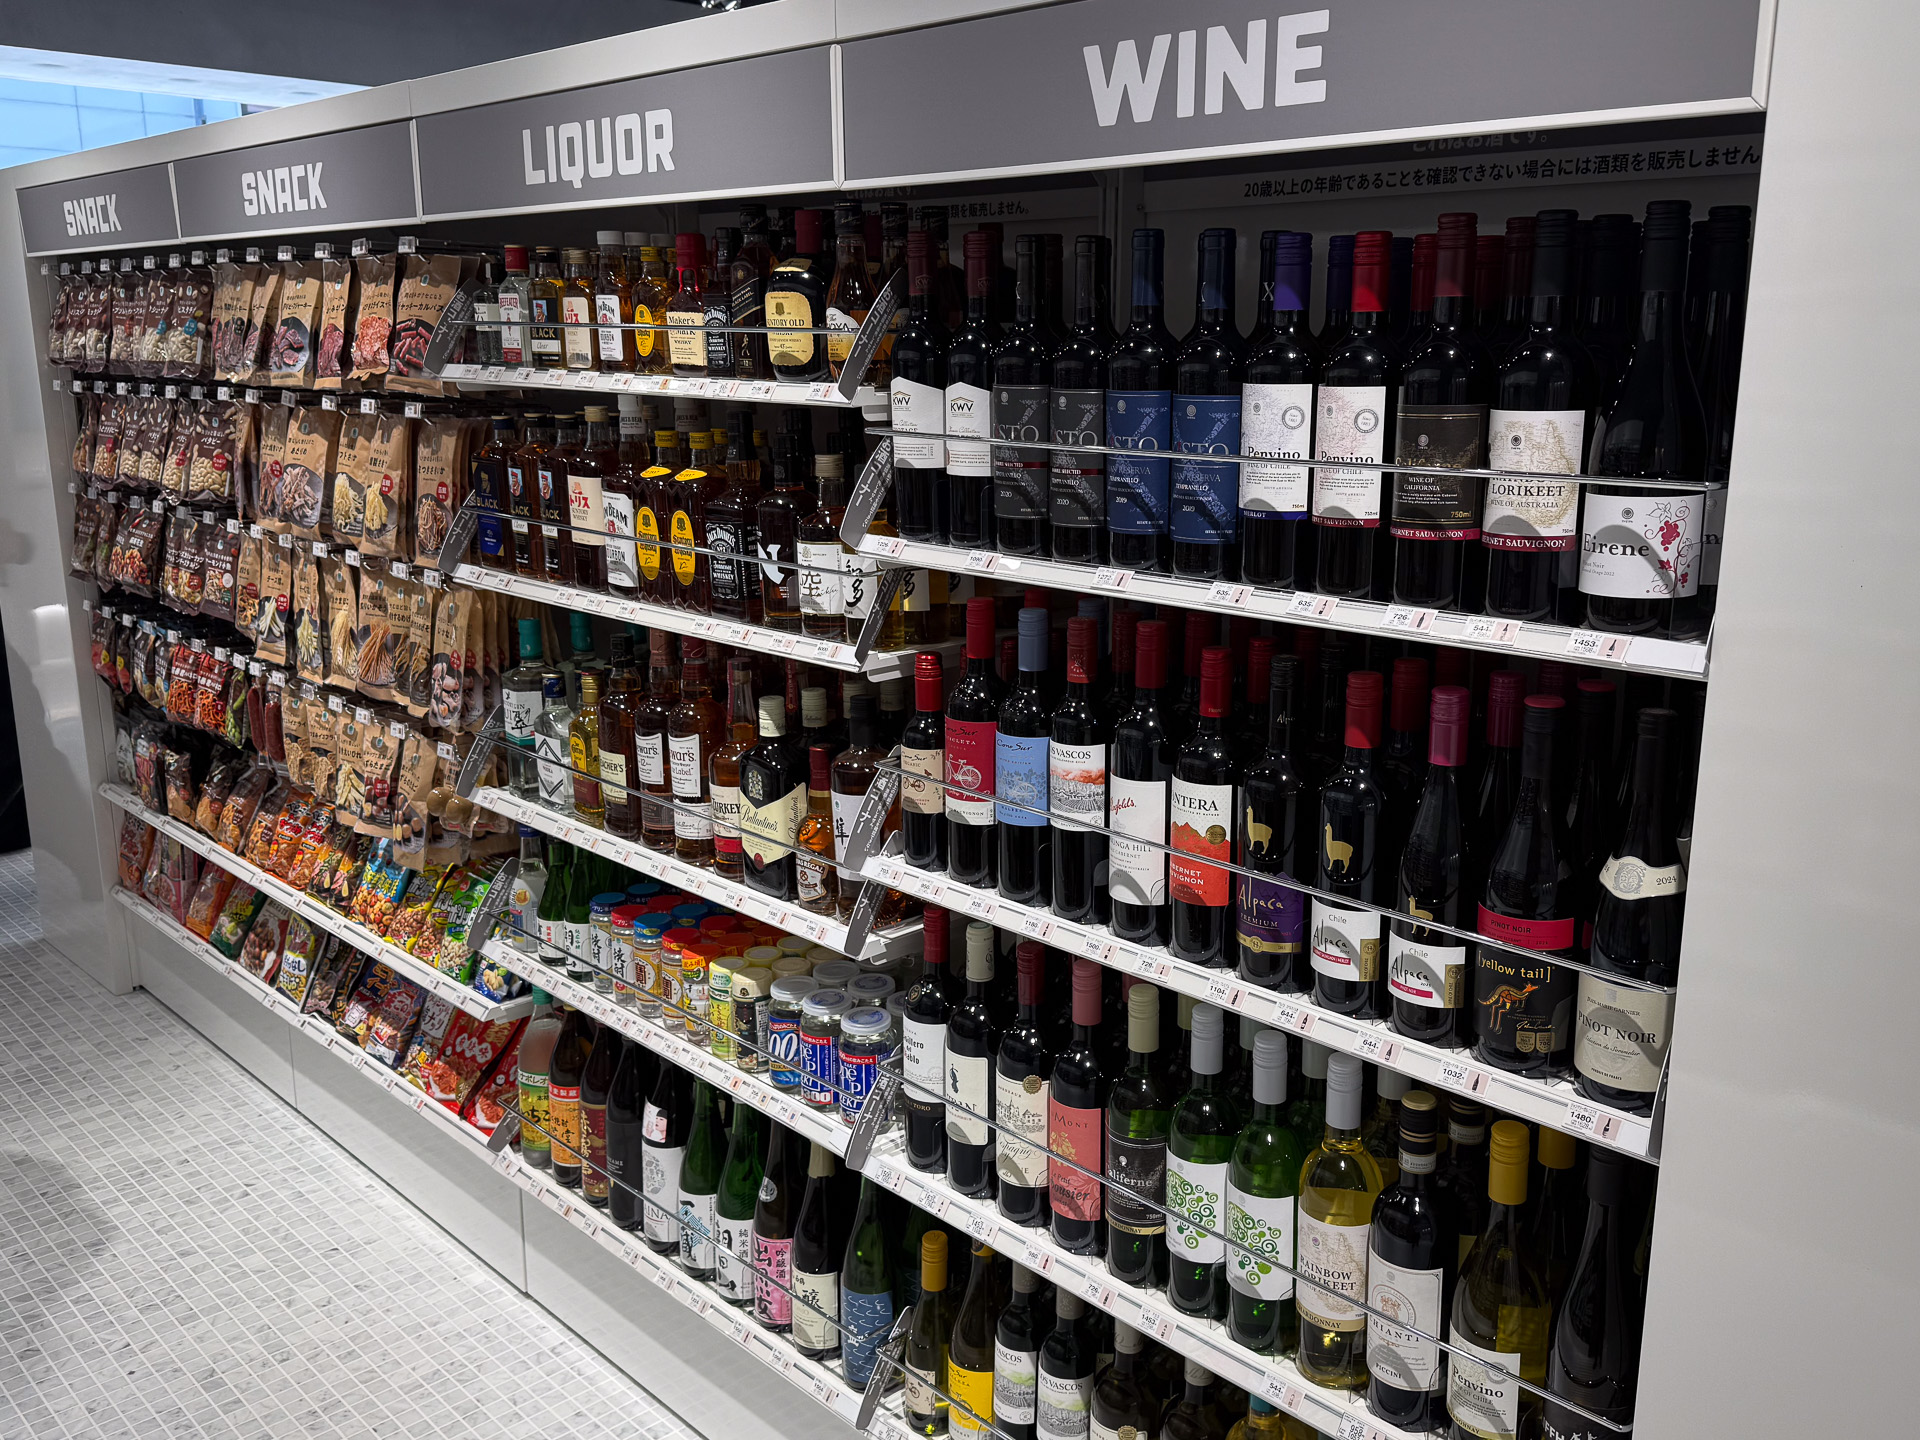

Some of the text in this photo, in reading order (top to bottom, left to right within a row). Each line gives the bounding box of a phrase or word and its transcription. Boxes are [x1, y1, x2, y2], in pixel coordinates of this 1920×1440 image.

[1083, 9, 1330, 127] WINE
[522, 107, 675, 189] LIQUOR
[240, 162, 329, 216] SNACK
[63, 194, 123, 237] SNACK
[668, 315, 695, 325] Maker's
[789, 318, 805, 327] OLD
[950, 402, 974, 412] KWV
[998, 424, 1039, 442] STO
[1055, 430, 1098, 446] STO
[200, 436, 221, 446] バタピー
[1247, 446, 1301, 460] Penvino
[1320, 451, 1374, 464] Penvino
[1491, 483, 1566, 497] LORIKEET
[476, 496, 499, 510] BLACK
[568, 496, 590, 509] トリス
[1182, 504, 1195, 512] 2019
[1490, 499, 1504, 507] WINE
[1505, 500, 1514, 508] OF
[608, 502, 628, 528] BEAM
[1323, 518, 1364, 526] SAUVIGNON
[1415, 530, 1464, 538] SAUVIGNON
[1505, 539, 1567, 548] SAUVIGNON
[1583, 532, 1650, 557] Eirene
[1573, 638, 1596, 648] 1453
[957, 725, 978, 736] Sur
[996, 738, 1033, 751] Cono Sur
[911, 753, 927, 762] Sur
[741, 803, 779, 833] Ballantine's
[1171, 863, 1202, 877] BERNET
[1656, 874, 1678, 887] 2024
[1238, 875, 1284, 916] Alpaca
[1240, 913, 1279, 928] PREMIUM
[1328, 914, 1347, 925] Chile
[1490, 919, 1532, 934] PINOT NOIR
[1313, 918, 1348, 952] Alpaca
[1408, 947, 1429, 959] Chile
[1391, 950, 1429, 985] Alpaca
[1578, 1011, 1657, 1045] PINOT NOIR
[1442, 1067, 1464, 1079] 1032
[804, 1091, 831, 1103] 300
[1054, 1112, 1089, 1129] MONT
[1569, 1110, 1592, 1123] 1480
[1145, 1212, 1163, 1220] 750ml
[738, 1227, 749, 1260] 純米酒
[775, 1248, 787, 1280] 吟醸酒
[1300, 1253, 1353, 1281] RAINBOW
[1375, 1361, 1403, 1380] PICCINI
[1049, 1380, 1084, 1391] VASCOS
[1269, 1382, 1282, 1393] 544
[1452, 1364, 1504, 1398] Penvino
